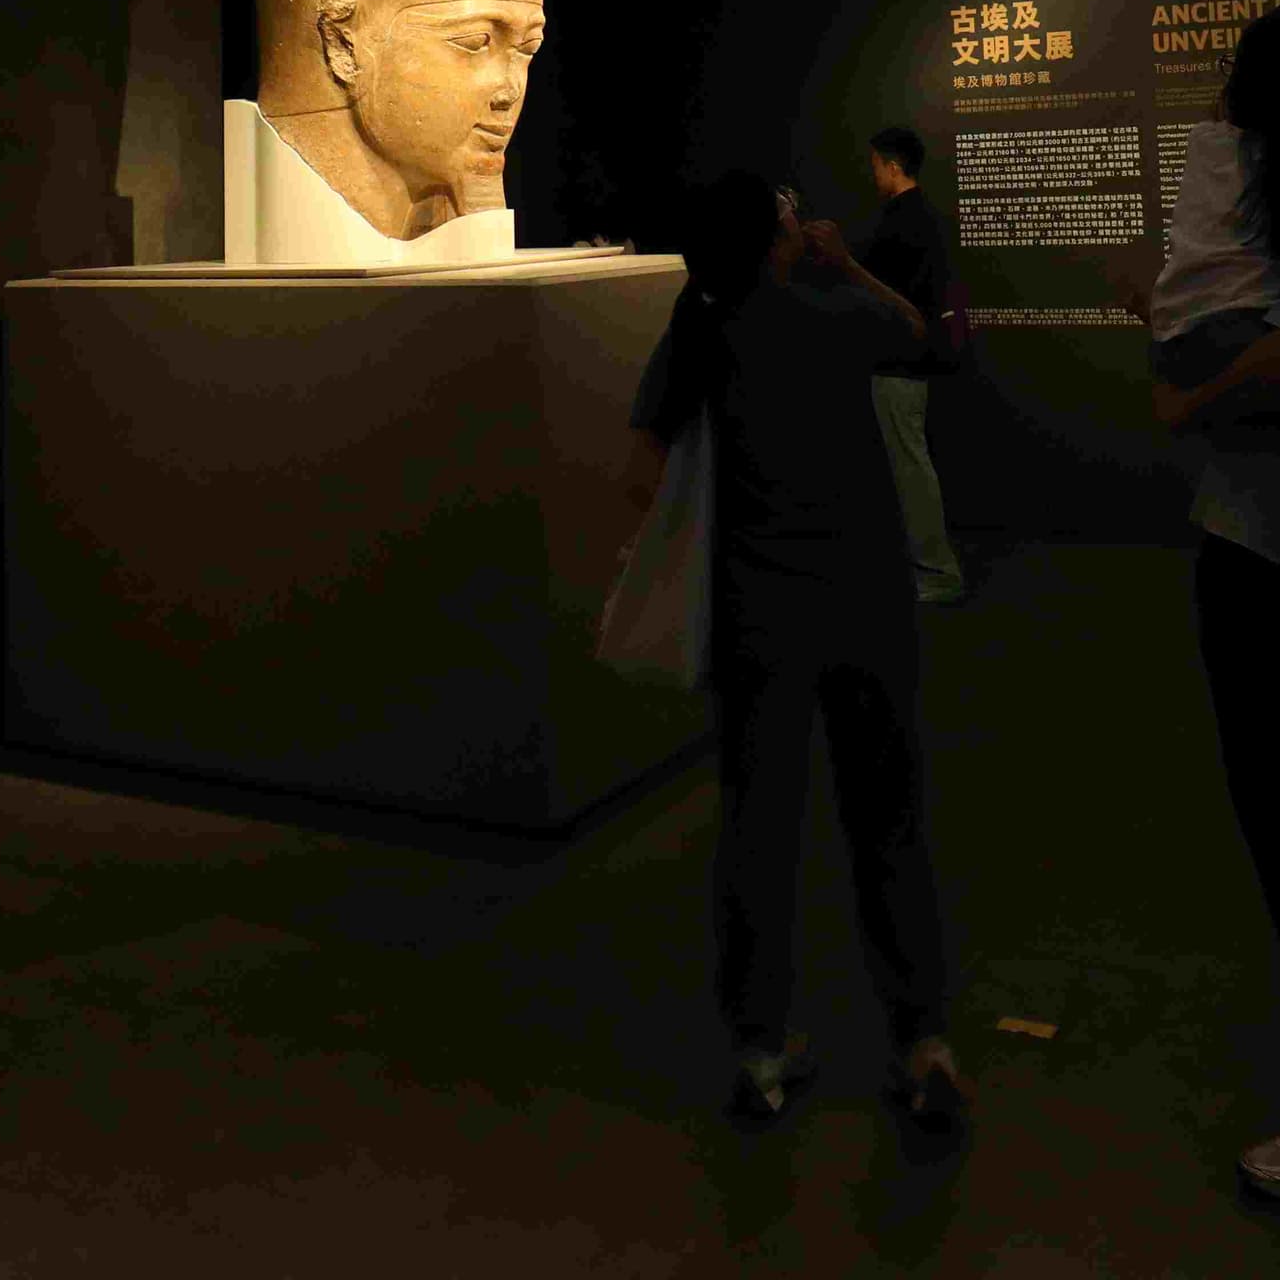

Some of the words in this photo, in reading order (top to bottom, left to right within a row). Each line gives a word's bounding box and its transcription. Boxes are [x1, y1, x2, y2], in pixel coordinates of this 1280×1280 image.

[950, 0, 1041, 35] 古埃及
[952, 30, 1074, 66] 文明大展
[953, 71, 1051, 89] 埃及博物館珍藏
[1154, 62, 1211, 74] Treasures
